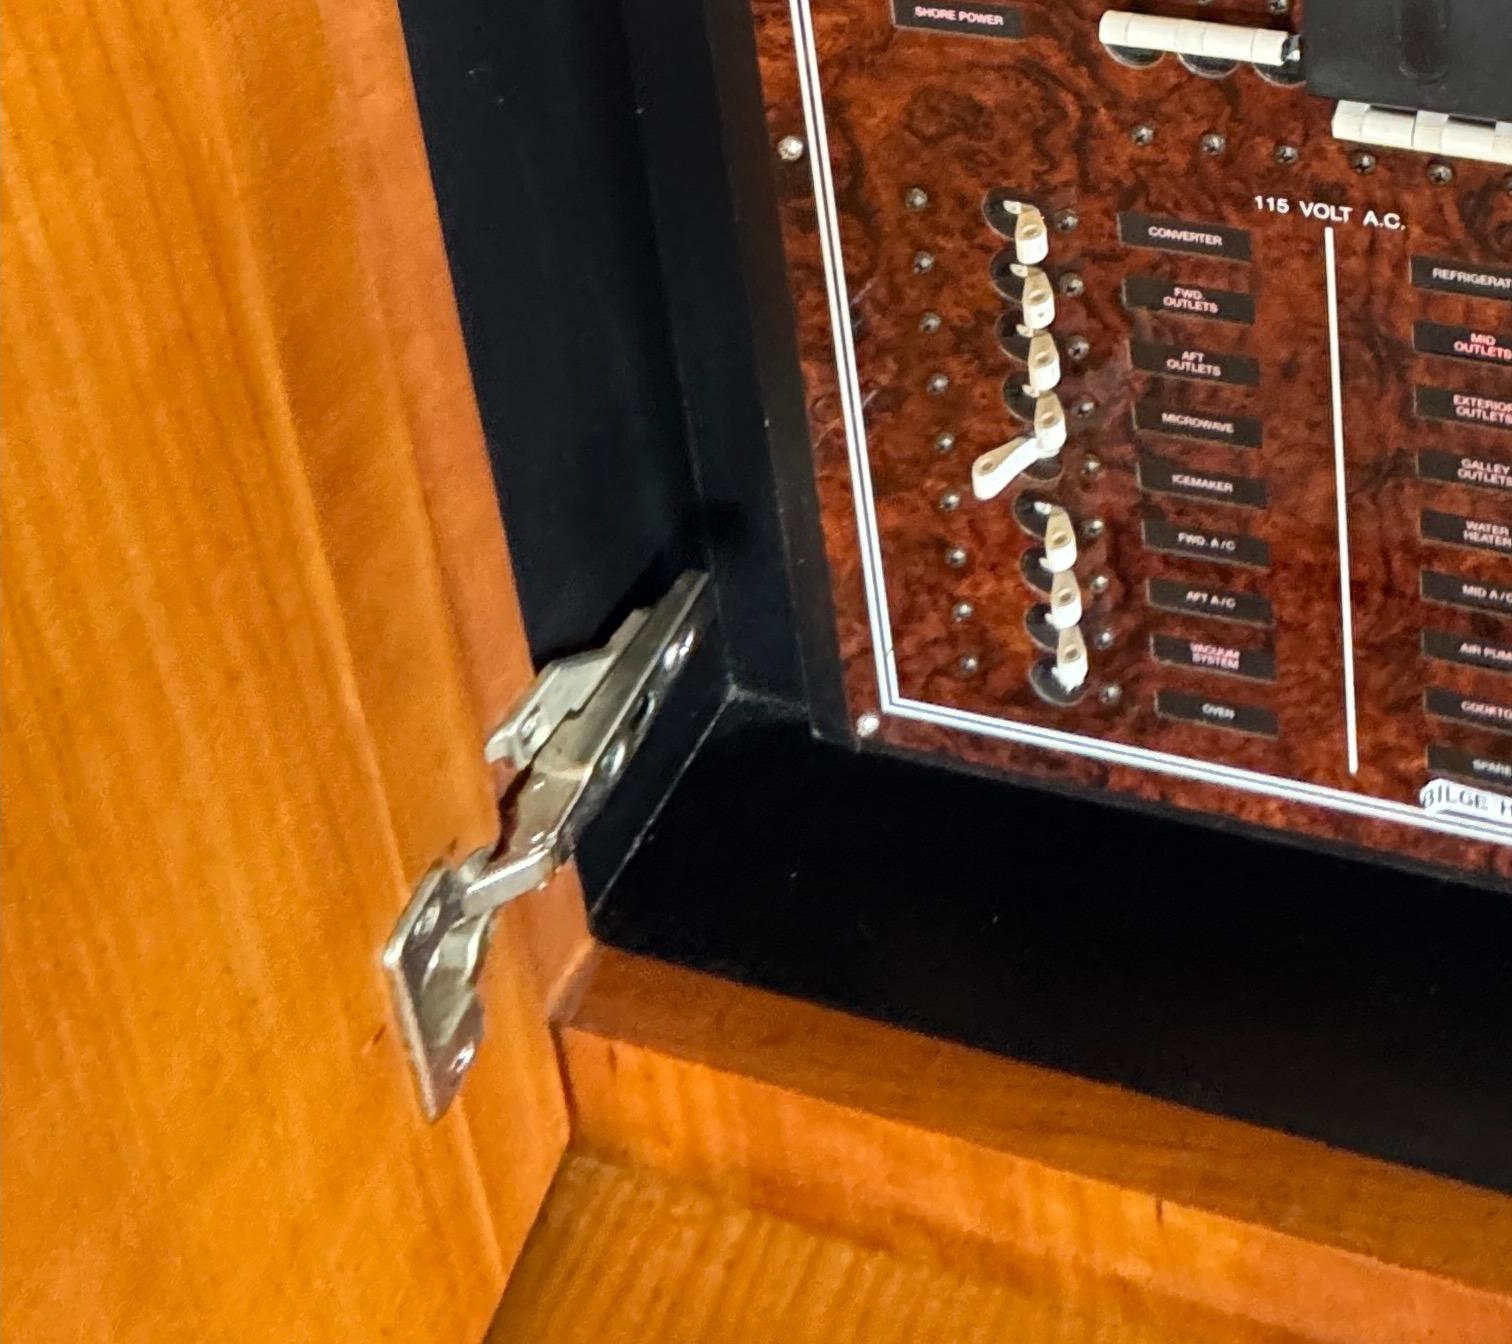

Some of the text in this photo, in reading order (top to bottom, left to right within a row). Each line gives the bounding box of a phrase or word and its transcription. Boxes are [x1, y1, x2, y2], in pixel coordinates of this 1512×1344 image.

[915, 6, 1004, 26] SHORE POWER
[1254, 196, 1406, 231] 115 VOLT A.C.
[1148, 226, 1222, 246] CONVERTER
[1163, 296, 1218, 313] OUTLETS
[1470, 332, 1496, 346] MID
[1181, 351, 1204, 362] AFT
[1453, 341, 1512, 360] OUTLETS
[1166, 359, 1221, 377] OUTLETS
[1161, 412, 1234, 433] MICROWAVE
[1461, 458, 1510, 475] GALLEY
[1172, 474, 1233, 493] ICEMAKER
[1466, 520, 1510, 536] WATER
[1463, 530, 1512, 549] HEATER
